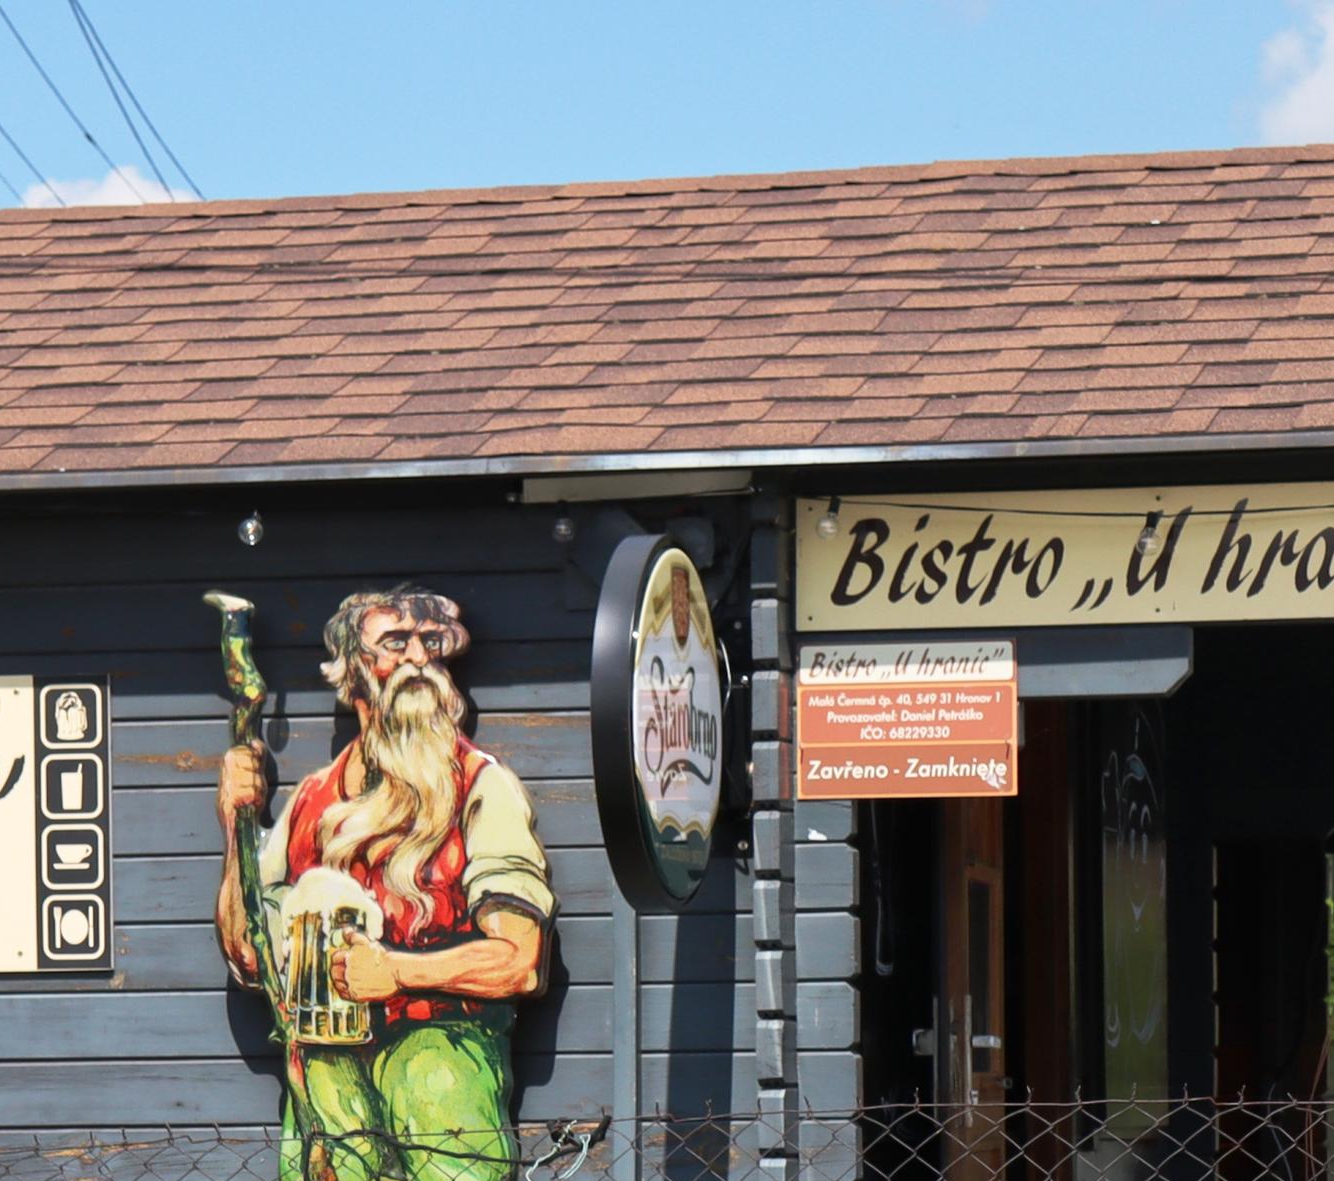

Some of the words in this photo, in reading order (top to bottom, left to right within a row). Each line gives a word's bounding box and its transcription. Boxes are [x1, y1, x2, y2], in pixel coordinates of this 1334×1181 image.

[830, 513, 1065, 606] Bistro
[809, 650, 877, 678] Bistro
[915, 693, 937, 704] 549
[939, 692, 952, 704] 31
[955, 691, 992, 704] Hronov
[995, 691, 1001, 703] 1
[827, 710, 898, 723] Provozovatel:
[901, 709, 936, 721] Daniel
[644, 655, 718, 798] Starobrno
[860, 724, 887, 739] IČO:
[889, 726, 950, 739] 68229330
[807, 760, 889, 780] Zavřeno
